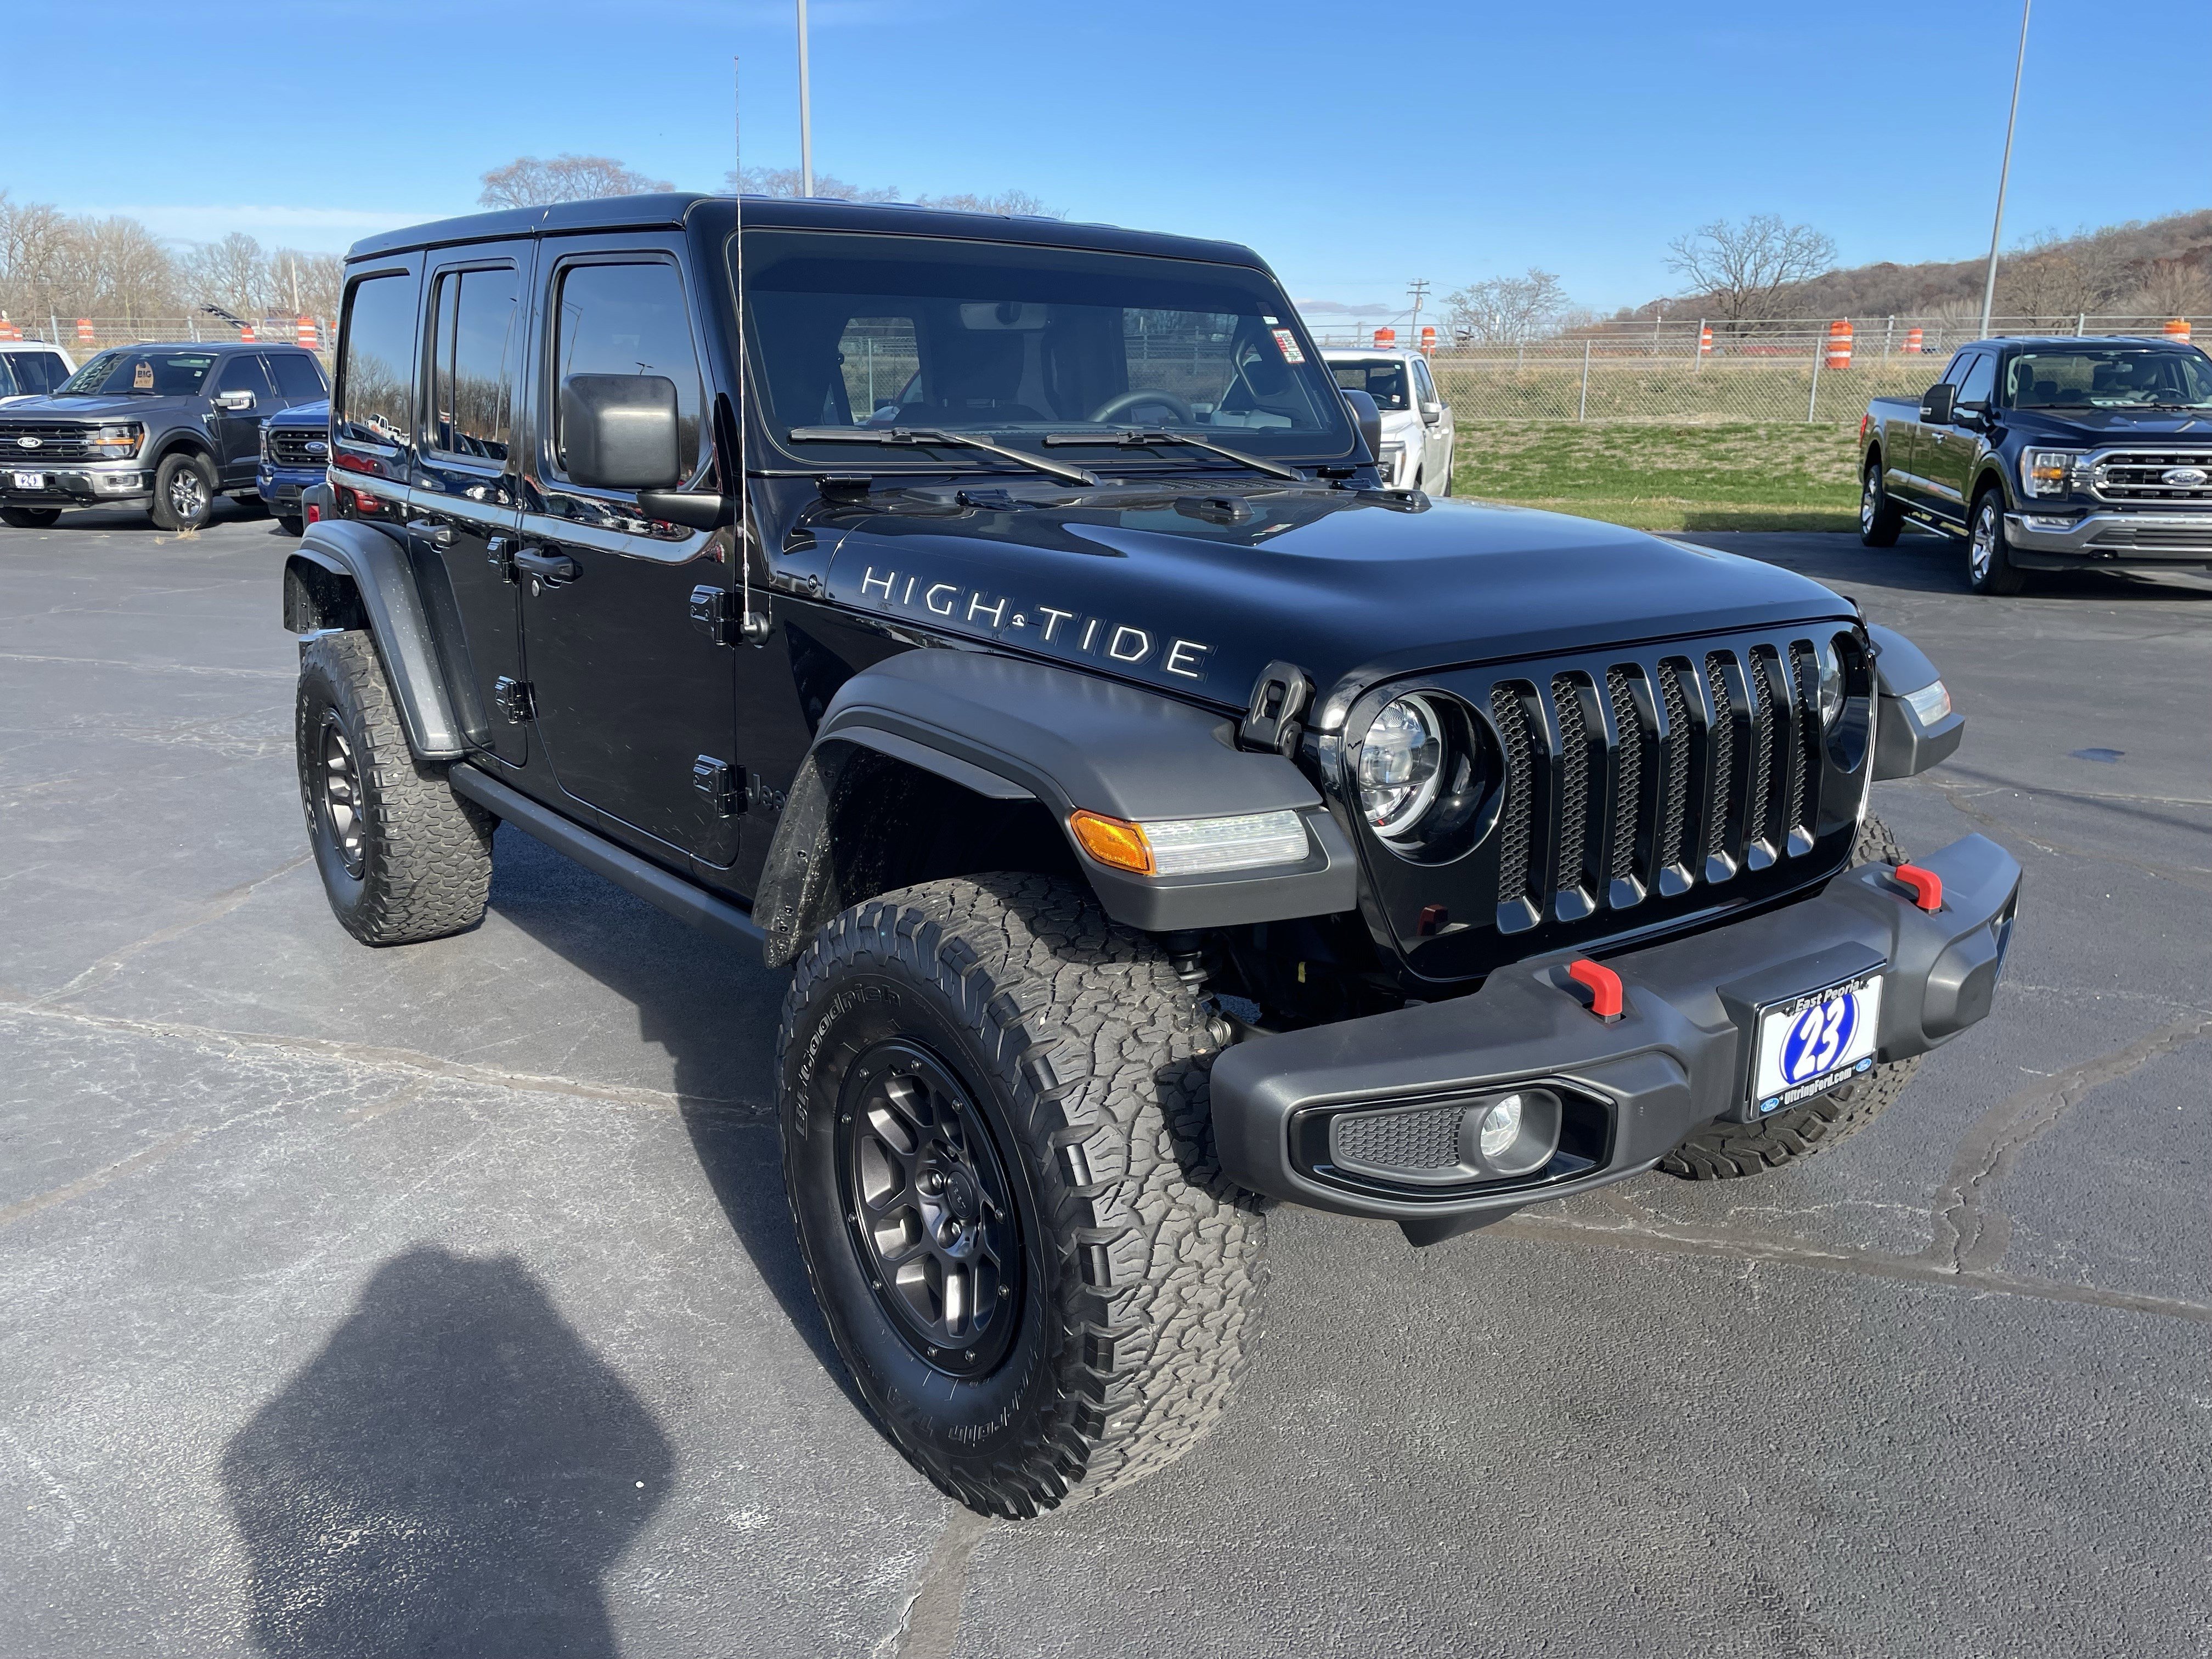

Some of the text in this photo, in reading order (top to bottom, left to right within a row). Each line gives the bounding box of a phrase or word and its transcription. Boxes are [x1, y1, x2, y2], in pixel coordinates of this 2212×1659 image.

[22, 475, 36, 487] 24
[861, 566, 1207, 678] HIGH TIDE
[745, 774, 787, 811] Jee
[1795, 979, 1860, 1013] East Peoria
[1793, 996, 1846, 1080] 23
